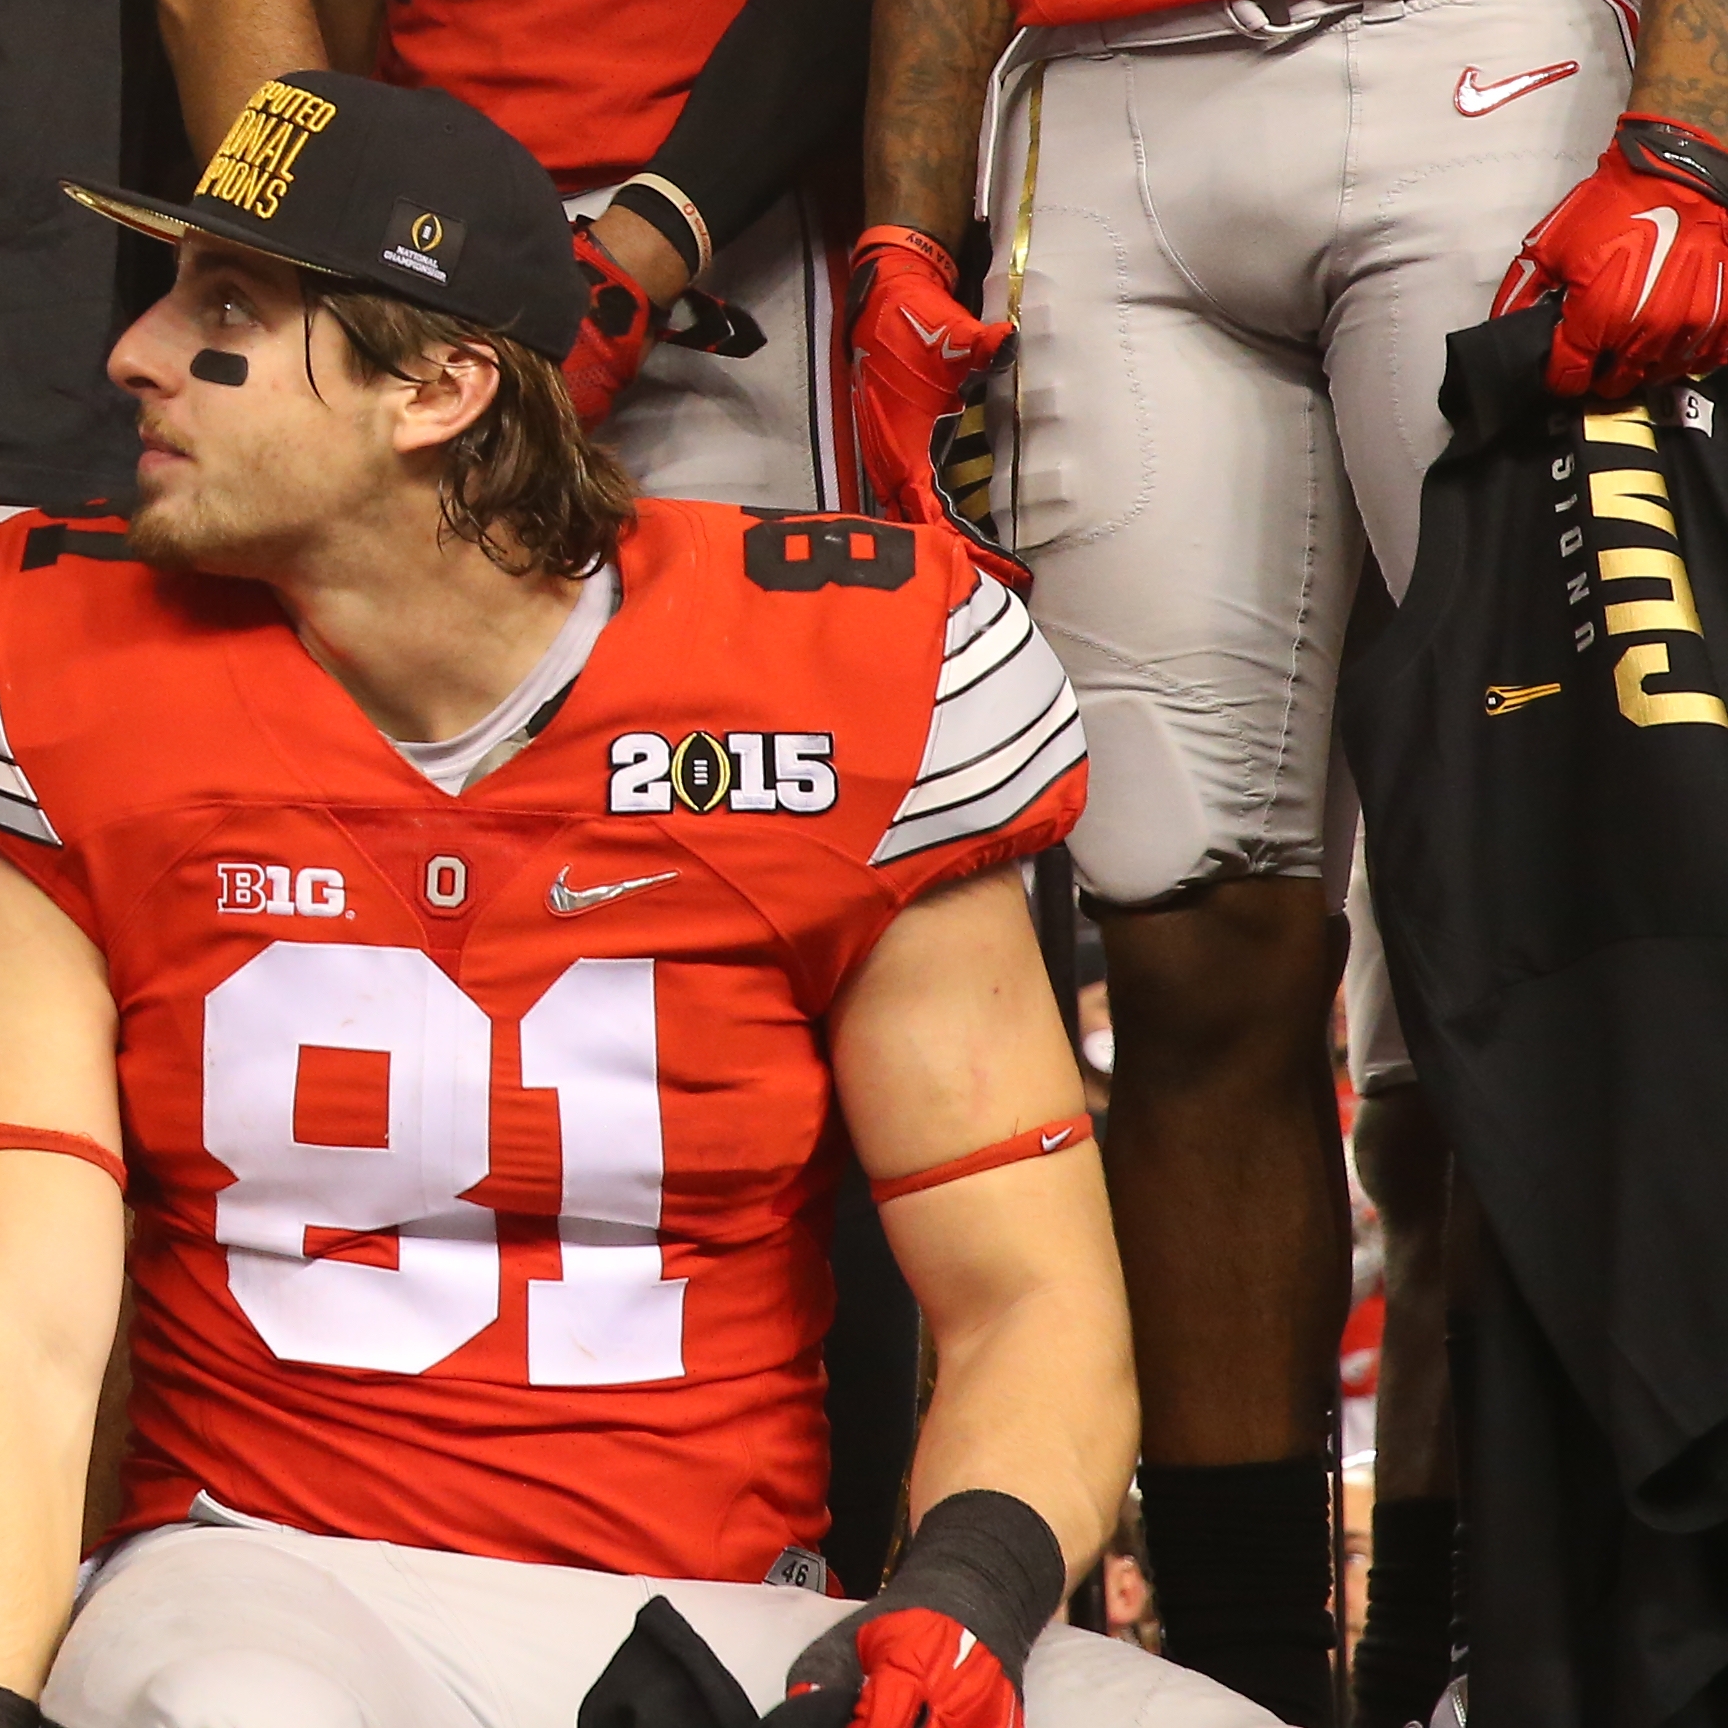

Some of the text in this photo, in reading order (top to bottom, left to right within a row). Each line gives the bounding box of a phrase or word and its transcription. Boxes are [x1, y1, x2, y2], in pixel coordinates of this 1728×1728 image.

[1551, 452, 1596, 653] UNDIS
[611, 732, 837, 814] 2015
[203, 941, 687, 1387] 81
[781, 1559, 809, 1588] 46
